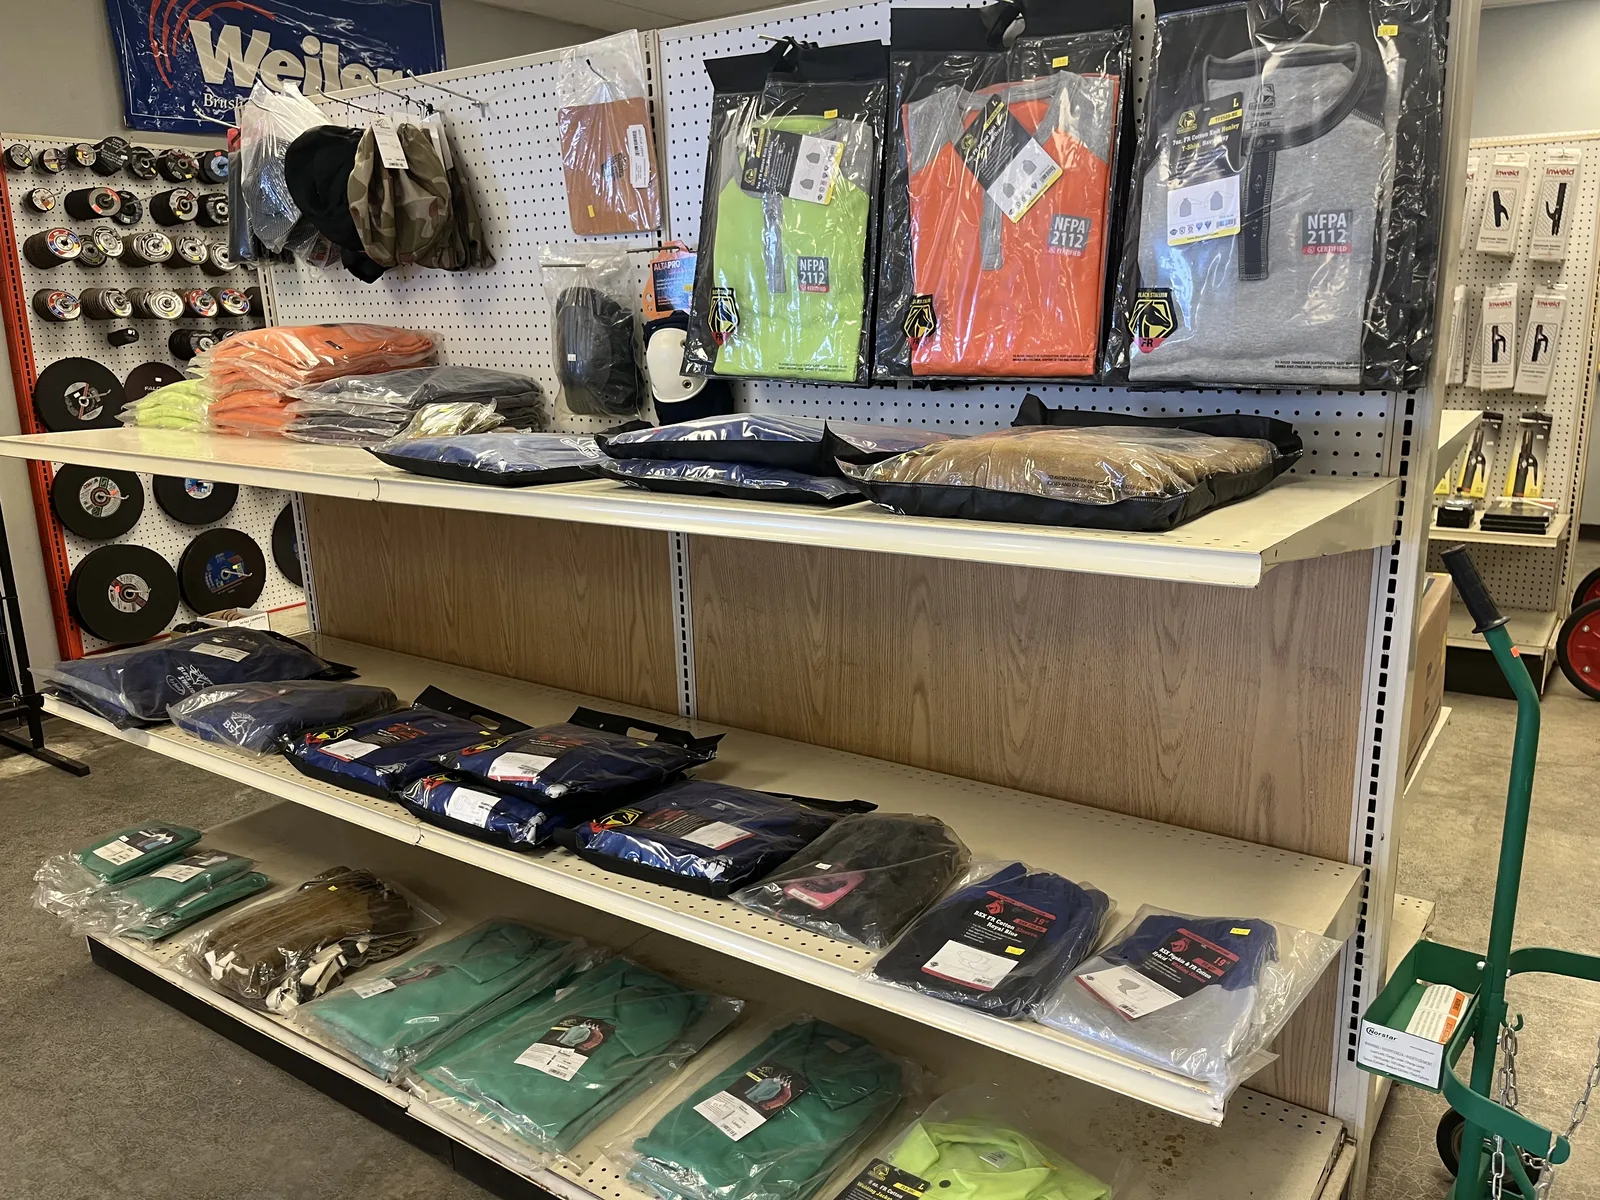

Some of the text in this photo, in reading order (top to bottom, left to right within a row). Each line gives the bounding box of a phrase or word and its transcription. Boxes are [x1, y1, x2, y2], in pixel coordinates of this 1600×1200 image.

[1233, 98, 1239, 107] L
[1192, 132, 1208, 141] Cotton
[1210, 128, 1220, 136] Knit
[1221, 123, 1240, 133] Henley
[1546, 168, 1575, 176] Inweld
[1055, 217, 1085, 233] NFPA
[1308, 213, 1347, 229] NFPA
[1051, 231, 1083, 248] 2112
[1308, 229, 1347, 244] 2112
[1317, 245, 1347, 253] CERTIFIED
[654, 260, 680, 271] ALTAPRO
[800, 259, 824, 271] NFPA
[800, 272, 825, 284] 2112
[1141, 338, 1154, 347] FR
[178, 676, 195, 693] STALLIO
[223, 719, 240, 739] BSX
[974, 910, 988, 919] BSX
[996, 918, 1015, 930] Cotton
[987, 922, 1004, 932] Royal
[1004, 929, 1018, 937] Blue
[1159, 947, 1170, 956] BSX
[1168, 952, 1185, 964] Pigskin
[1189, 963, 1197, 971] FR
[1196, 967, 1212, 979] Cotton
[1366, 1026, 1397, 1041] Norstar
[857, 1181, 876, 1195] Welding
[887, 1188, 903, 1199] Cotton
